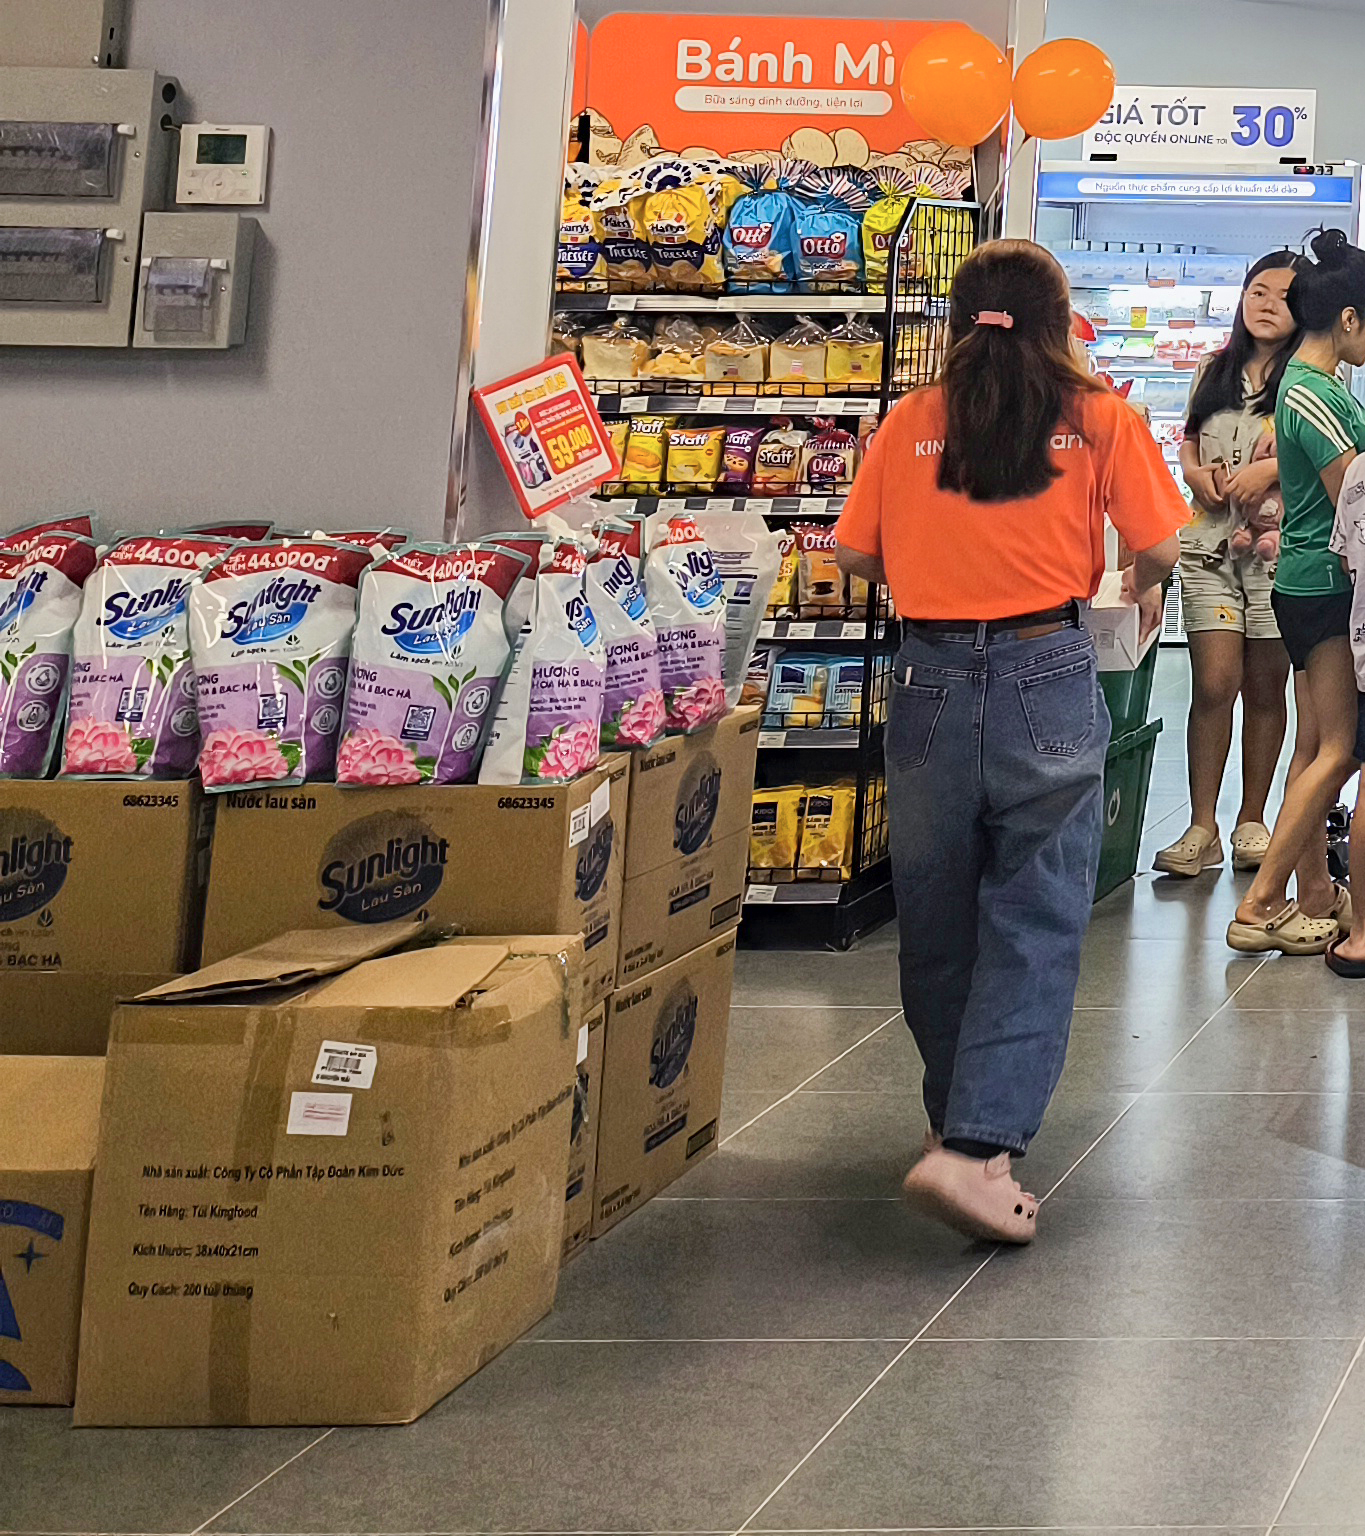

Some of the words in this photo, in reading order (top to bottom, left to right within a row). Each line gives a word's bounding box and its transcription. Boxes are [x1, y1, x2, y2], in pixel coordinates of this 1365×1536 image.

[676, 36, 813, 84] Bánh
[834, 40, 895, 86] Mì
[729, 95, 755, 107] sáng
[1151, 96, 1206, 126] TỐT
[1095, 133, 1121, 146] ĐỘC
[1170, 134, 1214, 144] ONLINE
[803, 238, 842, 255] Otto
[546, 423, 593, 469] 59.000
[669, 433, 711, 446] Staff
[122, 795, 179, 807] 68623345
[226, 793, 263, 811] Nước
[265, 794, 289, 810] lau
[291, 794, 317, 810] sàn
[497, 797, 555, 809] 68623345
[318, 835, 450, 912] Sunlight
[213, 1166, 241, 1182] Công
[244, 1166, 256, 1181] Ty
[210, 1205, 258, 1221] Kingfood
[196, 1244, 259, 1257] 38x40x21cm
[184, 1284, 201, 1297] 200
